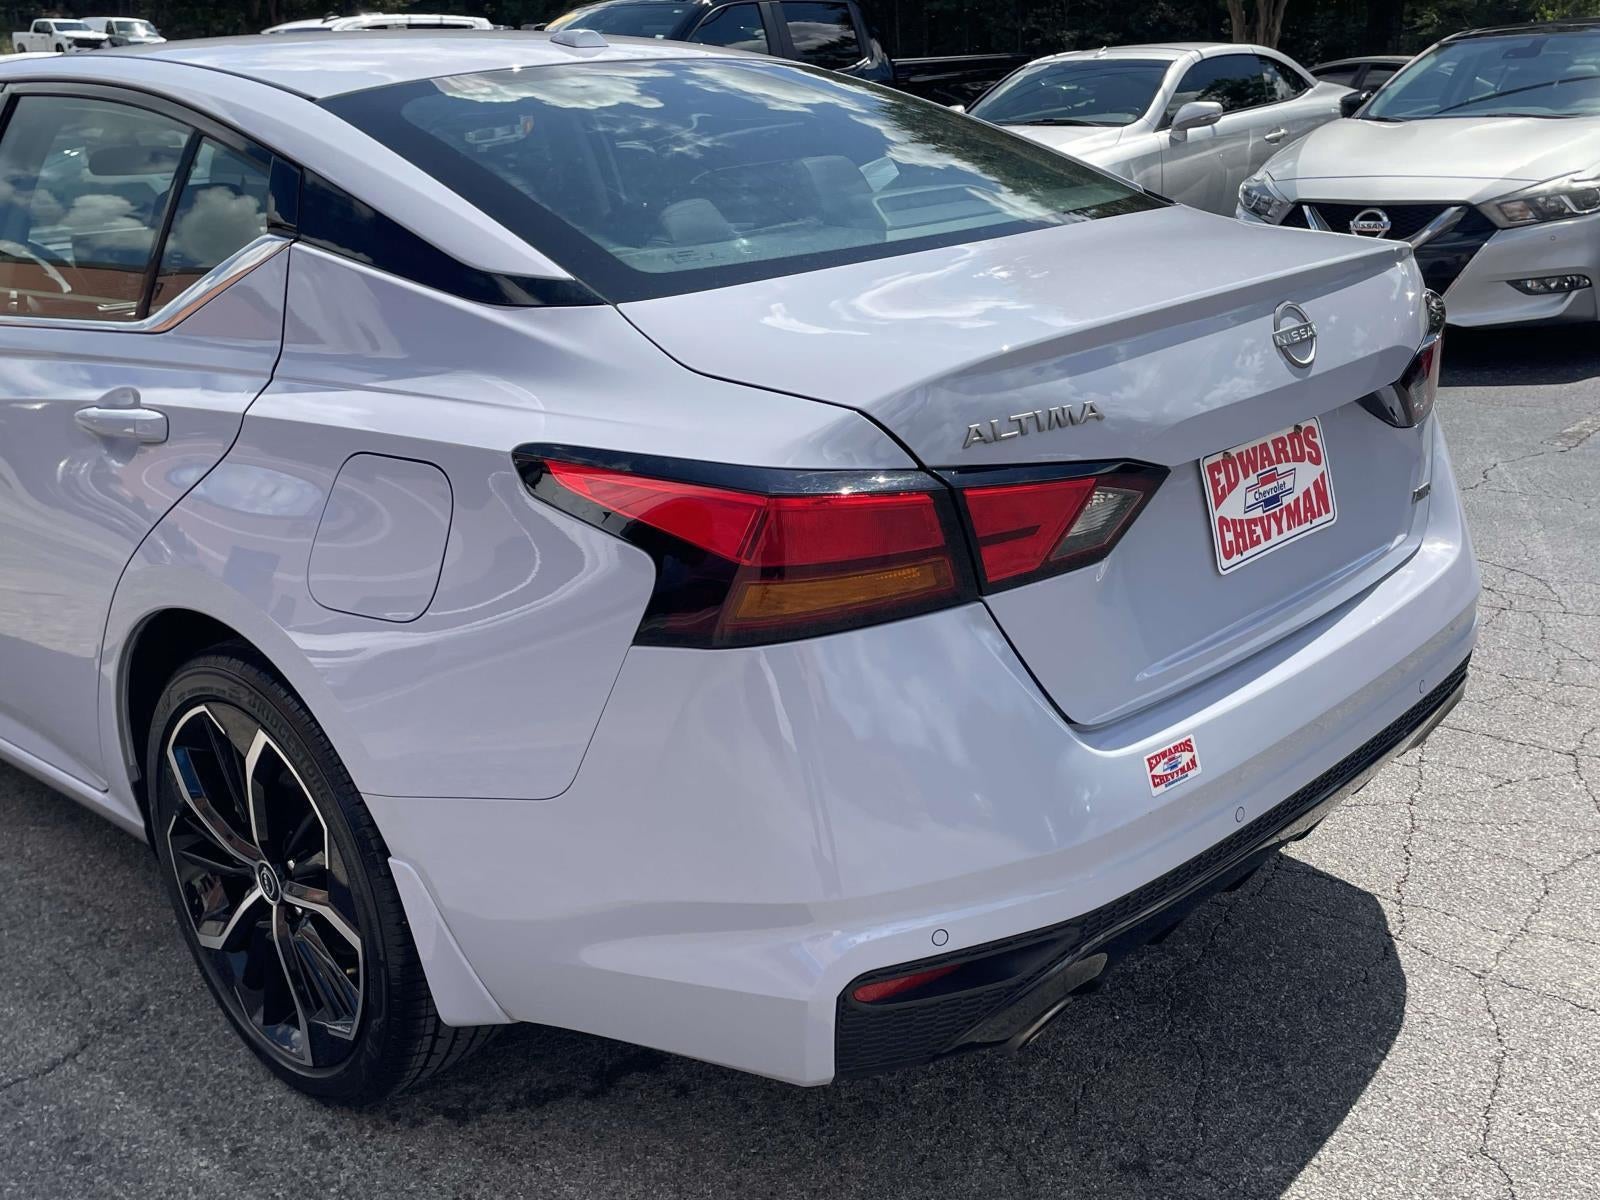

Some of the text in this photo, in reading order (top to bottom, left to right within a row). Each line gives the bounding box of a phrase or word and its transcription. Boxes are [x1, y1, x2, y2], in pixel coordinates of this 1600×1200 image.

[962, 400, 1105, 449] ALTIMA
[1206, 425, 1322, 511] EDWARDS
[1253, 480, 1286, 502] Chevrolet
[1217, 470, 1331, 561] CHEVYMAN
[1146, 738, 1194, 773] EDWARDS
[1151, 754, 1197, 788] CHEVYMAN
